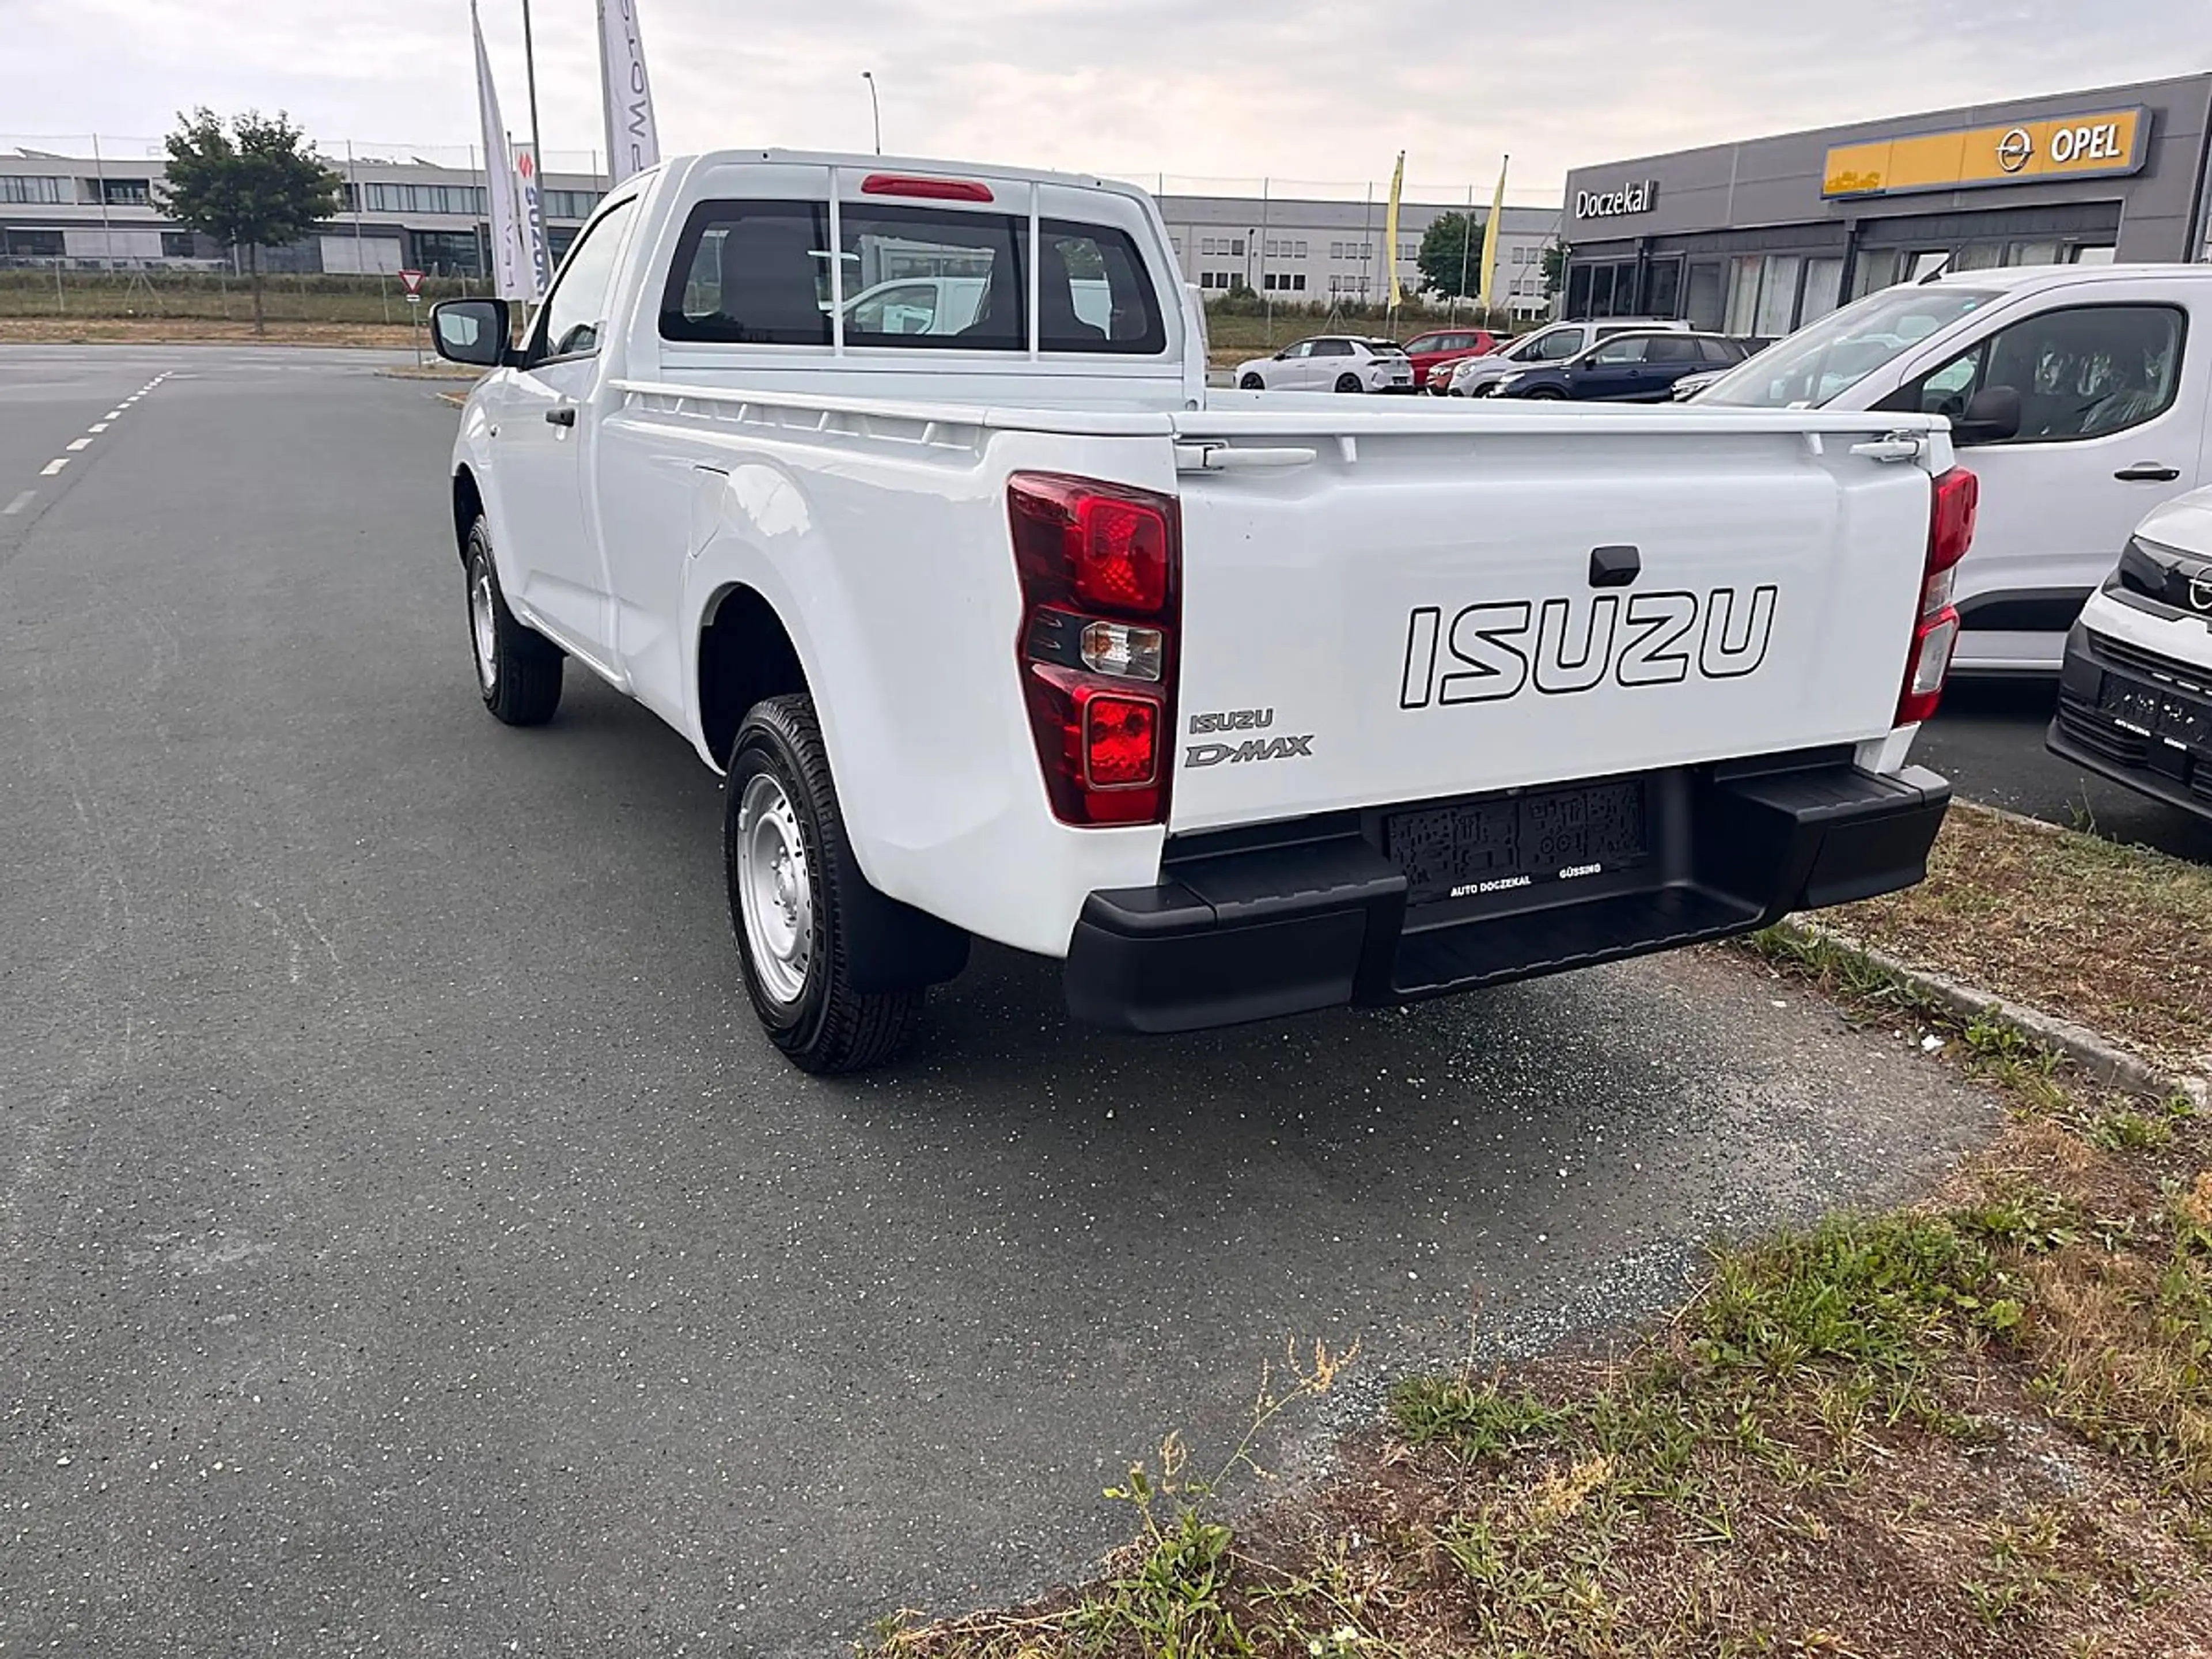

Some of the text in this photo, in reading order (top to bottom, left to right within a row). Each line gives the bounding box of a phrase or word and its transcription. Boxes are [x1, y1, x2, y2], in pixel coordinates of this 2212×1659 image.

[2051, 124, 2119, 162] OPEL
[1575, 179, 1649, 218] Doczekal
[1400, 585, 1778, 709] ISUZU
[1189, 708, 1273, 734] ISUZU
[1184, 735, 1314, 767] D-MAX
[1450, 884, 1478, 897] AUTO
[1480, 876, 1531, 893] DOCZEKAL
